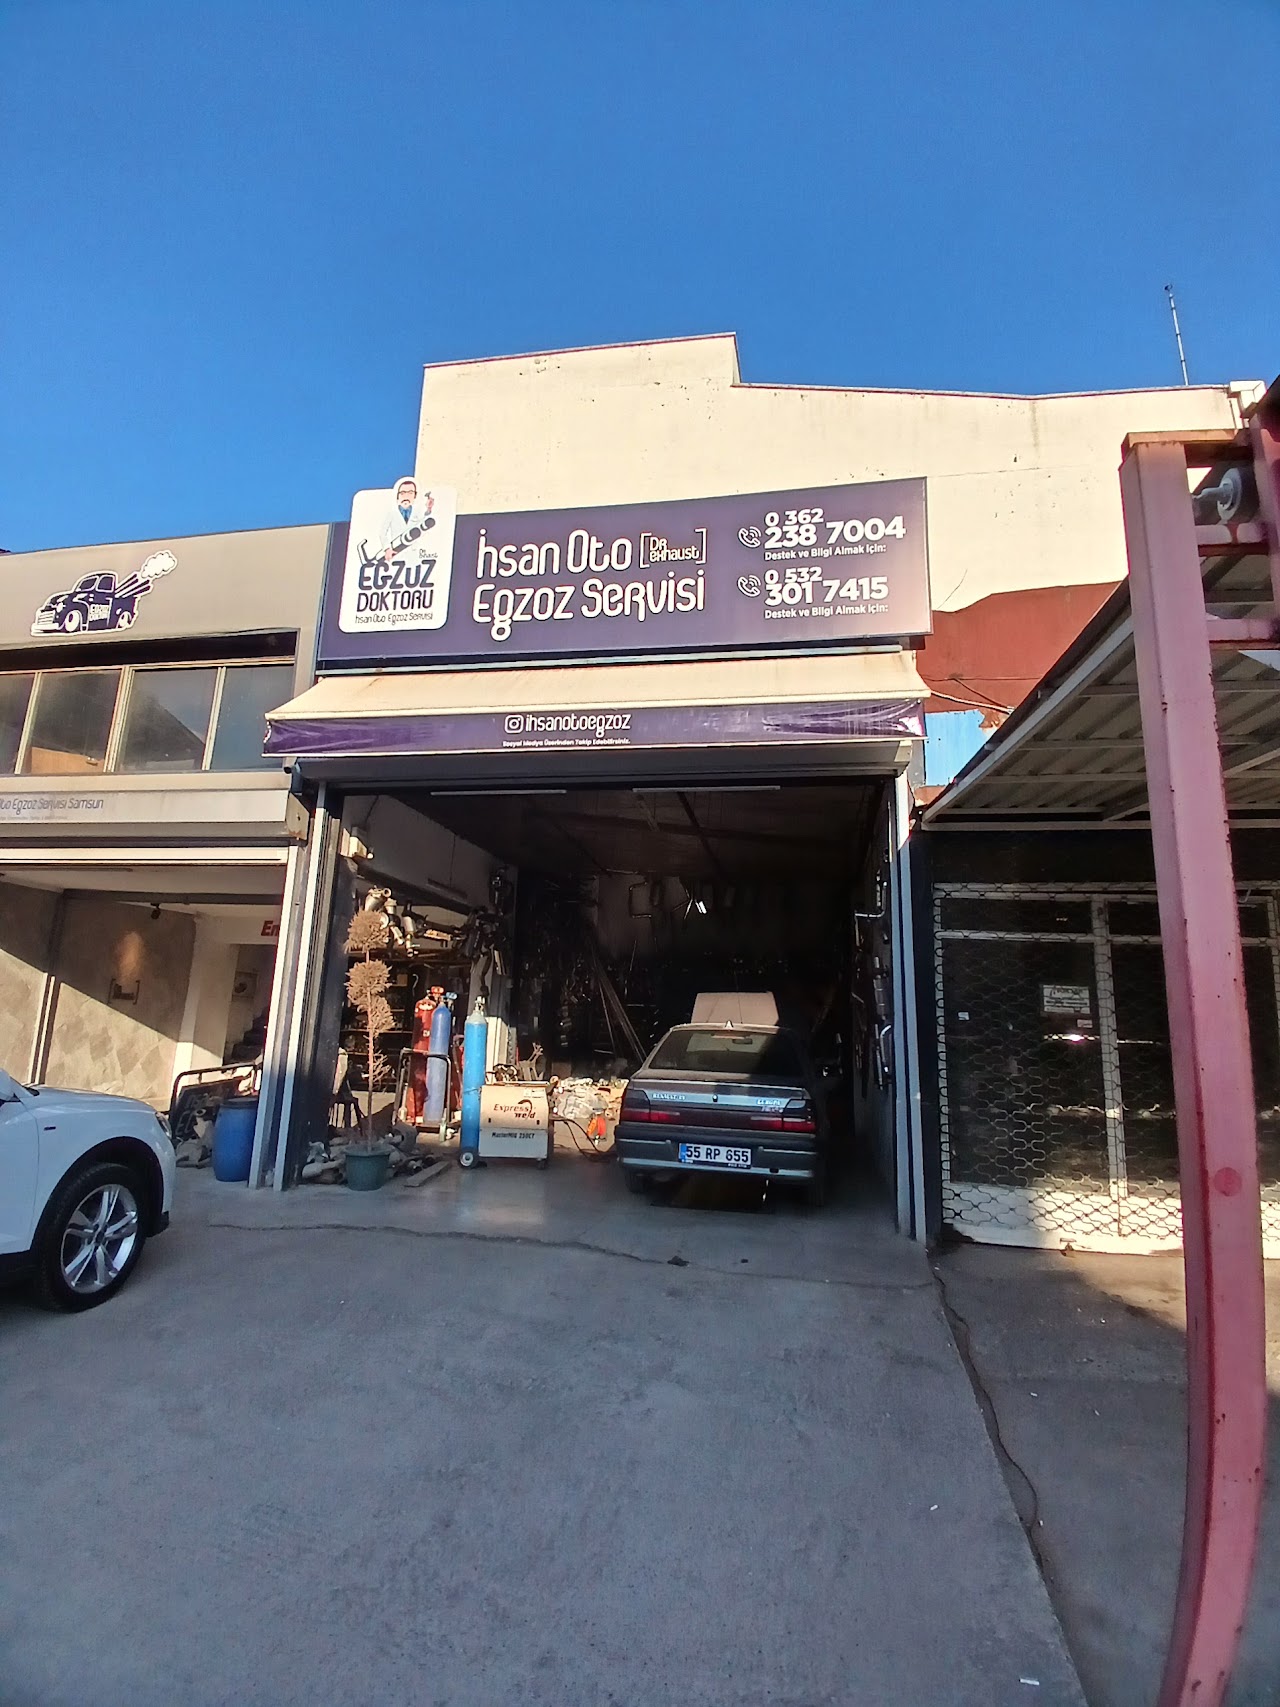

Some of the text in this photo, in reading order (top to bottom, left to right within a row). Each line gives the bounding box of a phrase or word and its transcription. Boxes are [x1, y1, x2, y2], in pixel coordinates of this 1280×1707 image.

[765, 507, 824, 527] 0 362
[764, 515, 906, 549] 238 7004
[567, 529, 633, 574] Oto
[764, 550, 797, 561] Destek
[798, 549, 810, 558] ve
[811, 546, 833, 558] Bilgi
[834, 543, 865, 556] Almak
[764, 566, 823, 585] 0 532
[356, 589, 434, 612] DOKTORU
[764, 576, 889, 606] 301 7415
[472, 583, 576, 642] Egzoz
[764, 608, 797, 619] Destek
[798, 608, 810, 617] ve
[811, 606, 834, 617] Bilgi
[835, 604, 866, 615] Almak
[526, 713, 632, 738] ihsanotoegzoz
[12, 798, 38, 816] Egzoz
[68, 797, 104, 810] Samsun
[493, 1103, 530, 1113] Express
[685, 1145, 749, 1163] 55 RP 655
